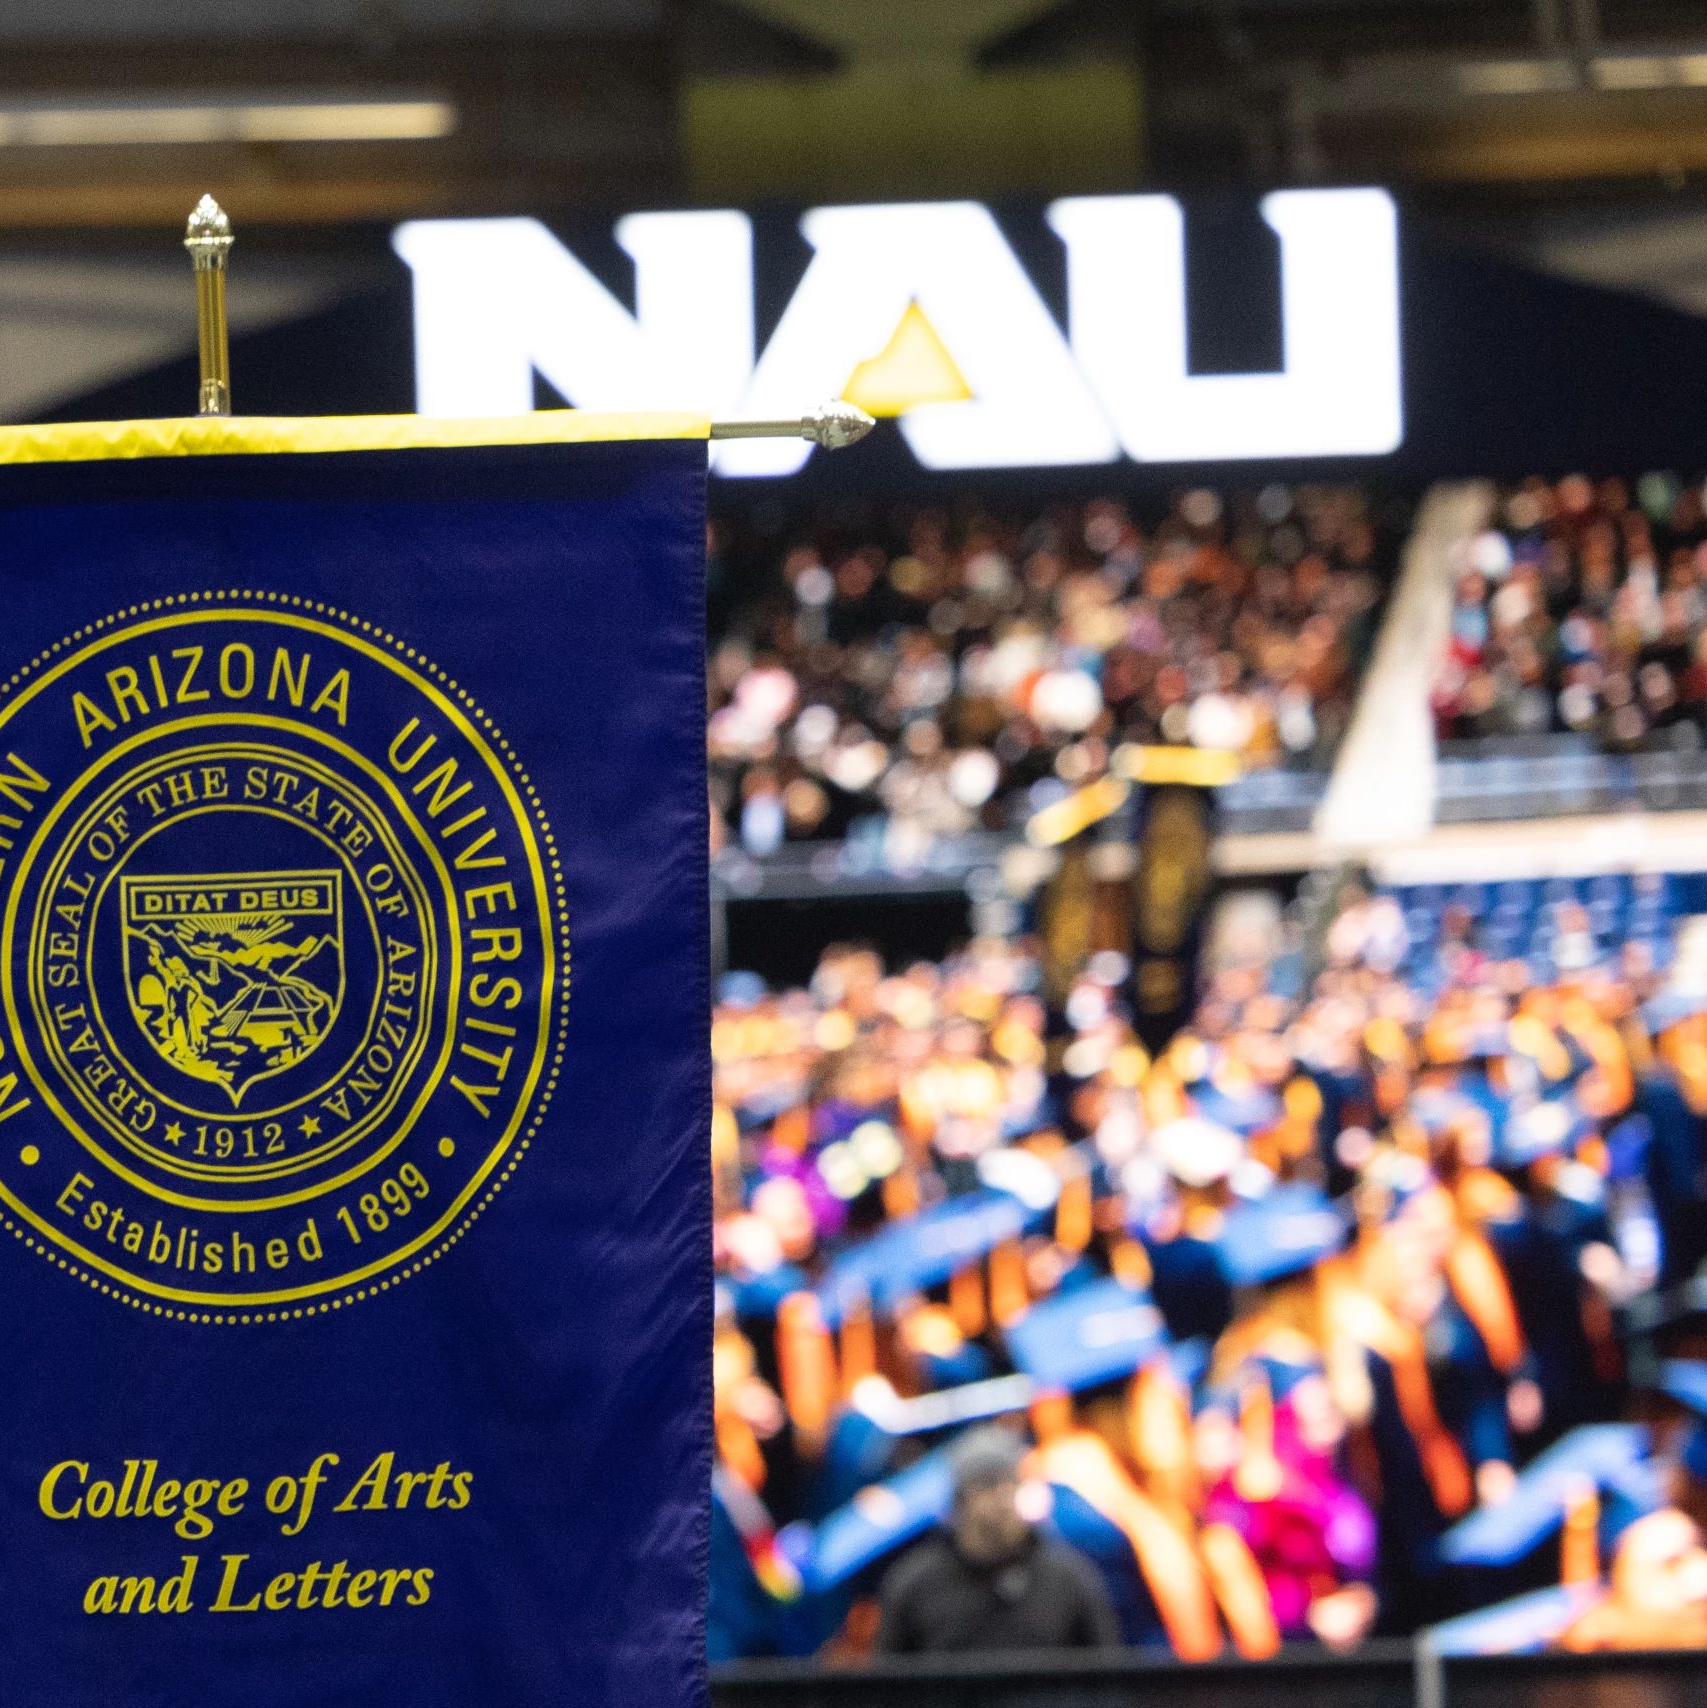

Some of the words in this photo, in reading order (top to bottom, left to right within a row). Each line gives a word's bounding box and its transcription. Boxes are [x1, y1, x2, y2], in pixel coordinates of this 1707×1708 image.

[391, 188, 1404, 476] NAU
[87, 808, 130, 860] OF
[137, 766, 228, 820] THE
[243, 767, 373, 856] STATE
[71, 642, 351, 749] ARIZONA
[388, 717, 523, 1118] UNIVERSITY
[144, 892, 235, 914] DITAT
[240, 887, 319, 911] DEUS
[365, 861, 409, 918] OF
[48, 866, 95, 988] SEAL
[54, 1002, 158, 1132] GREAT
[320, 936, 416, 1123] ARIZONA
[192, 1123, 287, 1158] 1912
[55, 1172, 323, 1274] Established
[336, 1160, 431, 1246] 1899
[38, 1459, 249, 1540] College
[265, 1453, 340, 1536] of
[333, 1451, 474, 1513] Arts
[82, 1555, 199, 1615] and
[208, 1553, 435, 1613] Letters
